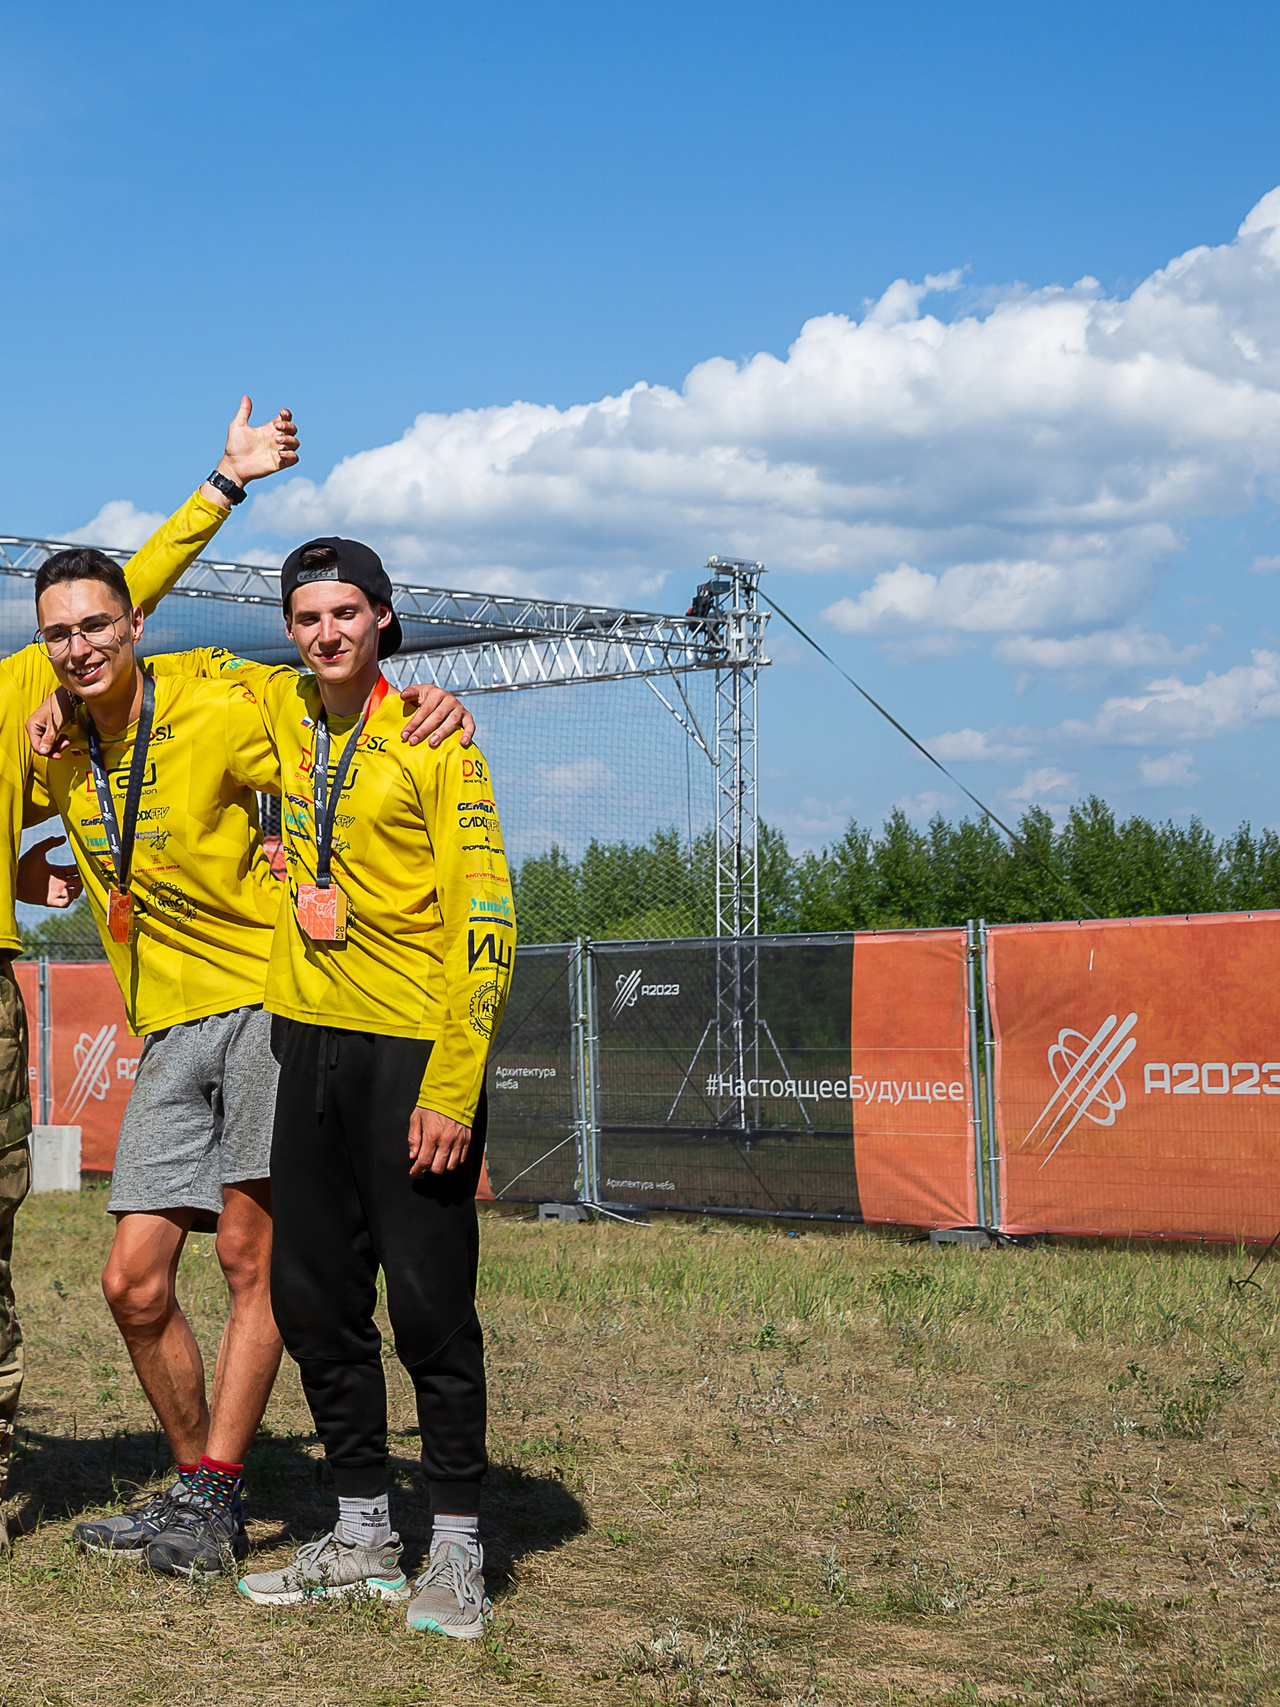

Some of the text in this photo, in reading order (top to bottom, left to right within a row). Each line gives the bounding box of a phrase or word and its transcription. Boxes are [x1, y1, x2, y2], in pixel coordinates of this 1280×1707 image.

[641, 984, 680, 996] A2023
[495, 1066, 557, 1079] Архитектура
[1143, 1062, 1280, 1095] A2023
[495, 1078, 519, 1089] неба
[705, 1073, 964, 1106] #НастоящееБудущее
[606, 1178, 676, 1191] Архитектура неба
